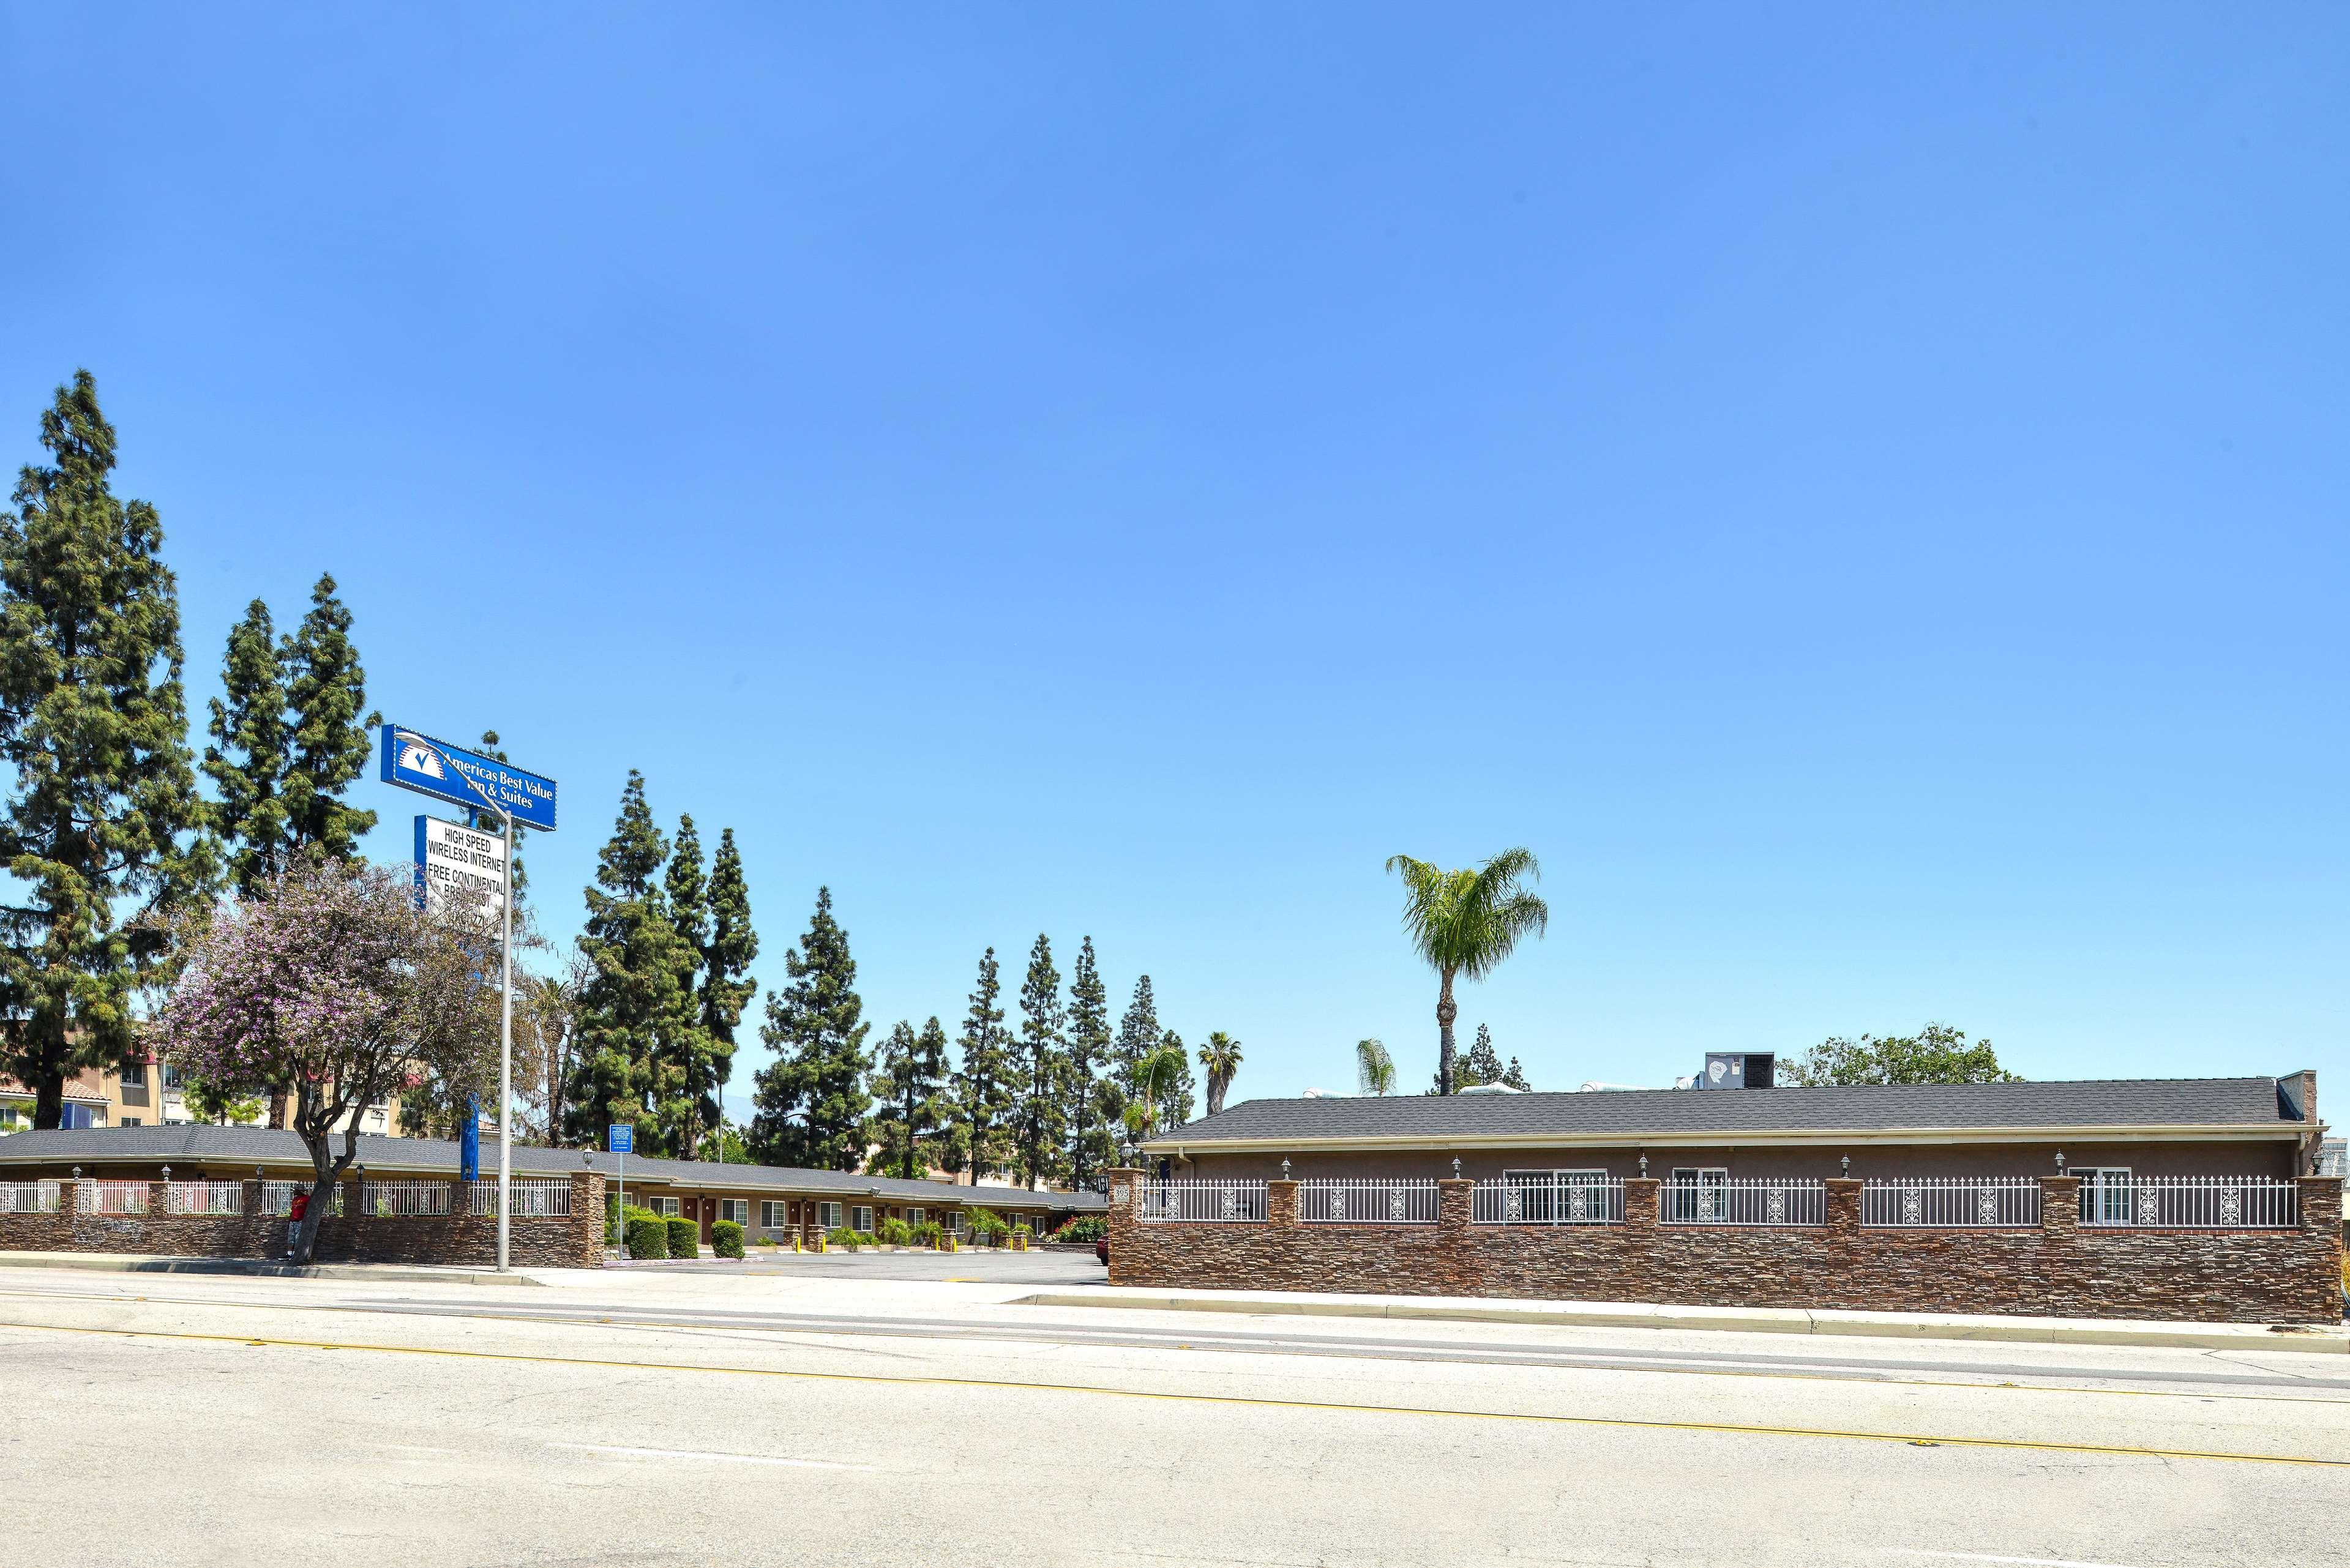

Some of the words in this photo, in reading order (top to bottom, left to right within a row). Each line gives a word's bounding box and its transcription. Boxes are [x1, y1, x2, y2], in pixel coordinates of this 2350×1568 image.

[443, 753, 497, 782] Americas
[500, 771, 522, 791] Best
[525, 780, 553, 801] Value
[488, 783, 497, 797] &
[500, 786, 533, 808] Suites
[445, 827, 463, 846] HIGH
[466, 834, 490, 853] SPEED
[428, 840, 468, 863] WIRELESS
[470, 851, 504, 873] INTERNET
[428, 863, 450, 881] FREE
[452, 869, 504, 895] CONTINENTAL
